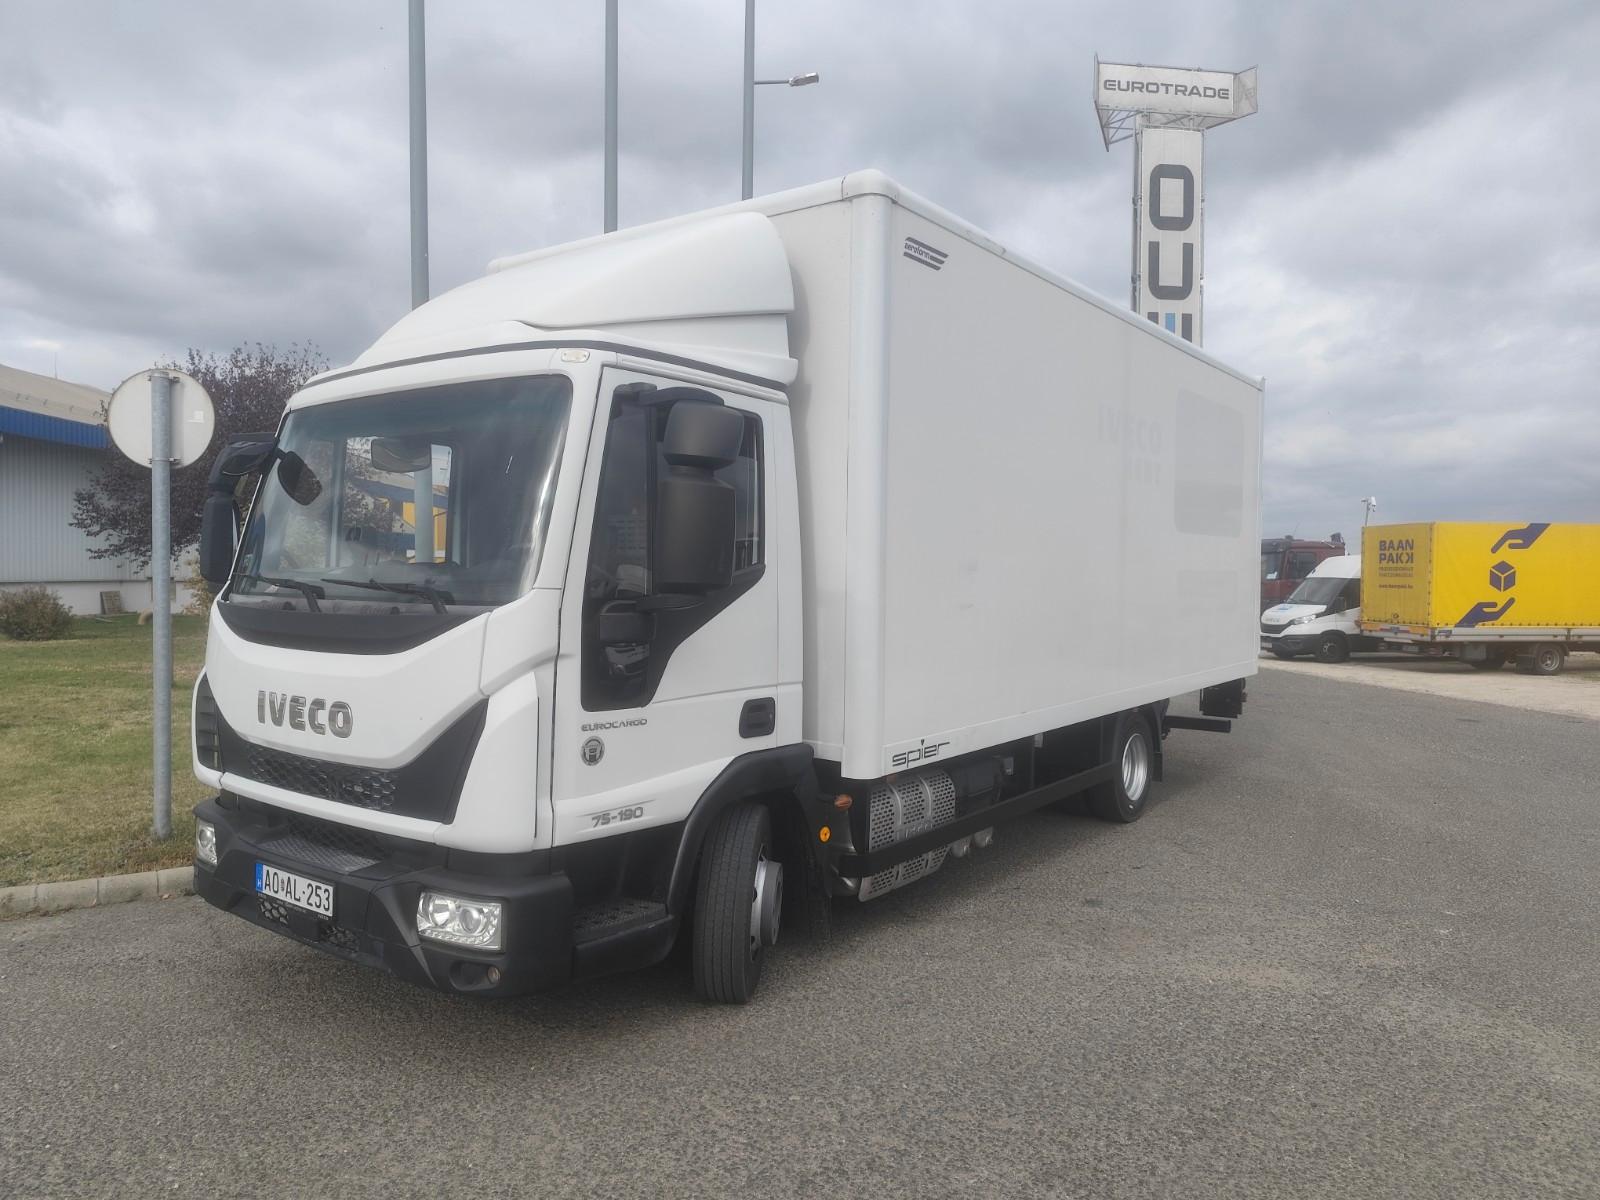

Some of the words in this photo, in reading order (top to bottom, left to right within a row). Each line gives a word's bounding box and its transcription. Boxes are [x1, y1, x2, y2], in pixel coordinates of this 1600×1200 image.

[1104, 79, 1230, 100] EUROTRADE
[1379, 539, 1414, 551] BAAN
[1379, 552, 1414, 564] PAKK
[257, 690, 354, 738] IVECO
[581, 718, 648, 732] EUROCARGO
[892, 738, 950, 768] spier
[591, 806, 644, 828] 75-190
